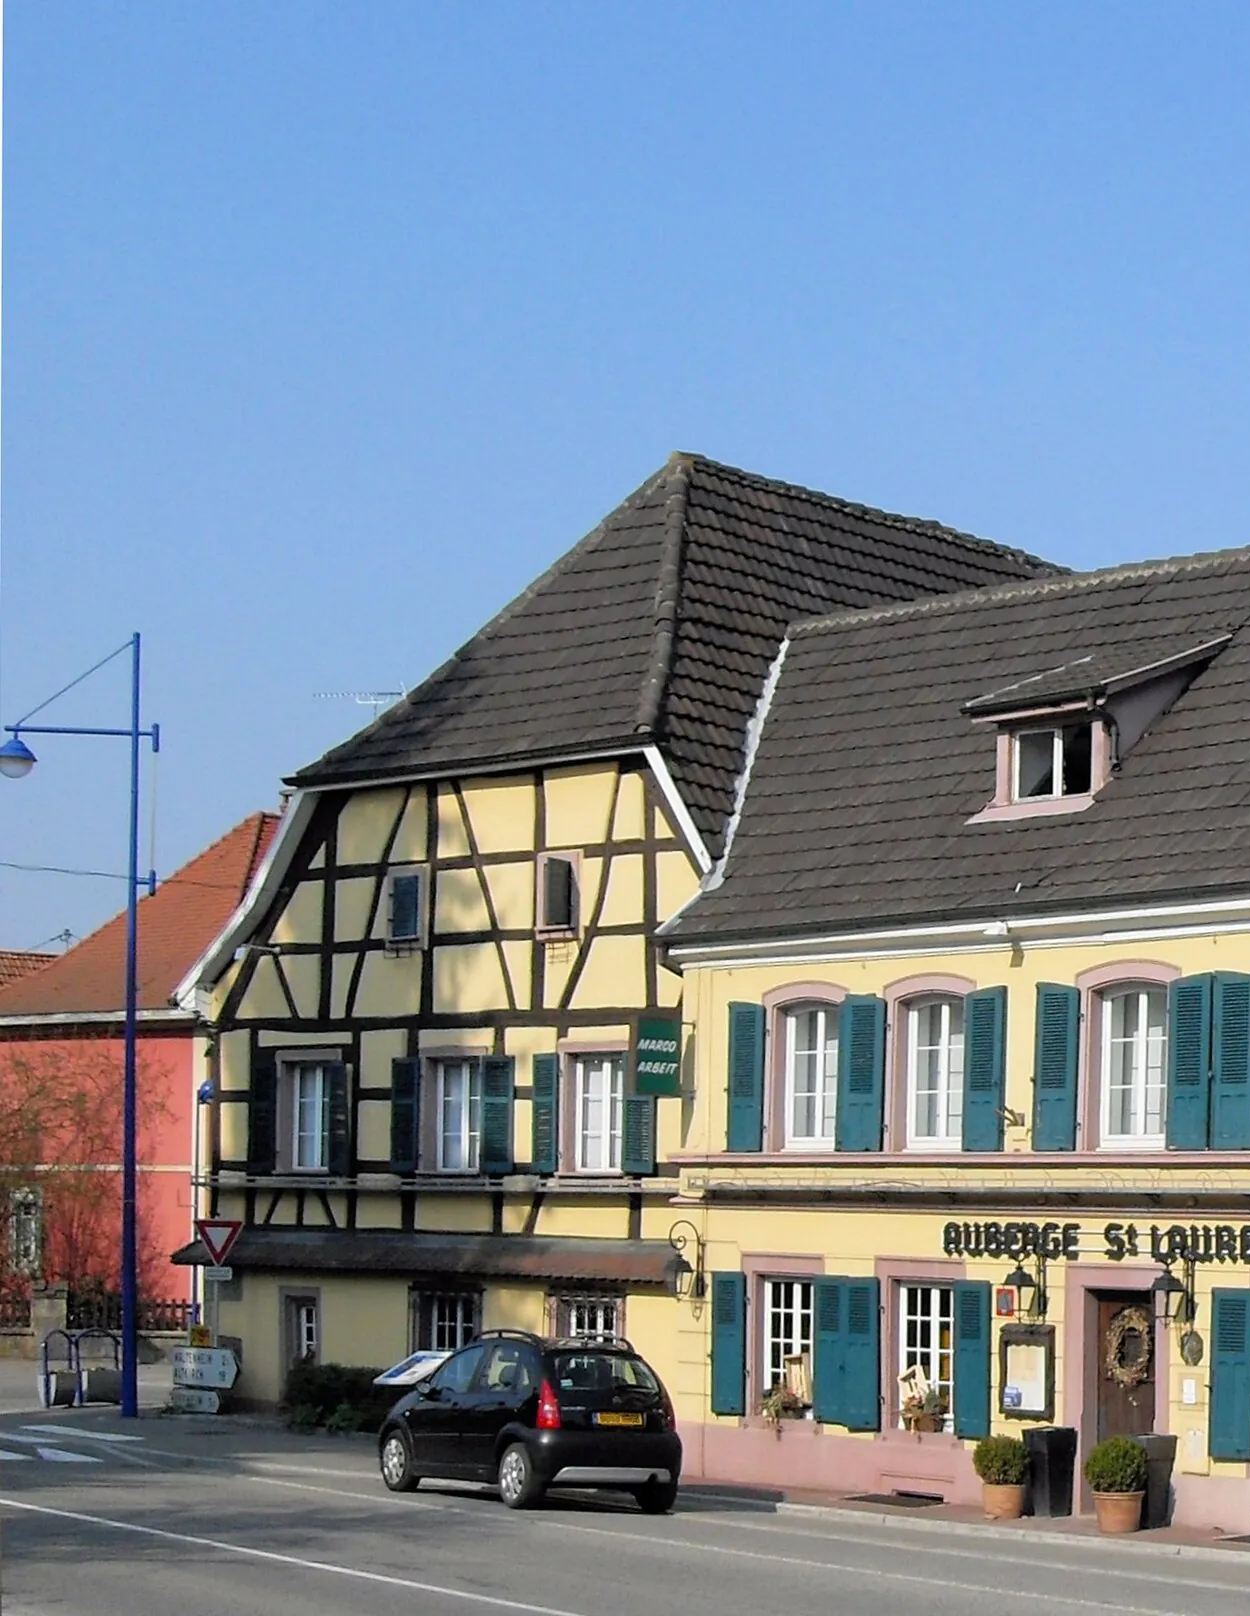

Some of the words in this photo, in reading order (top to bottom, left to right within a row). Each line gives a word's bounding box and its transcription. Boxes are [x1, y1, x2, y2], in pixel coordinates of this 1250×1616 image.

[637, 1039, 678, 1053] MARCO
[637, 1061, 679, 1076] ARBEIT
[944, 1222, 1081, 1262] AUBERGE
